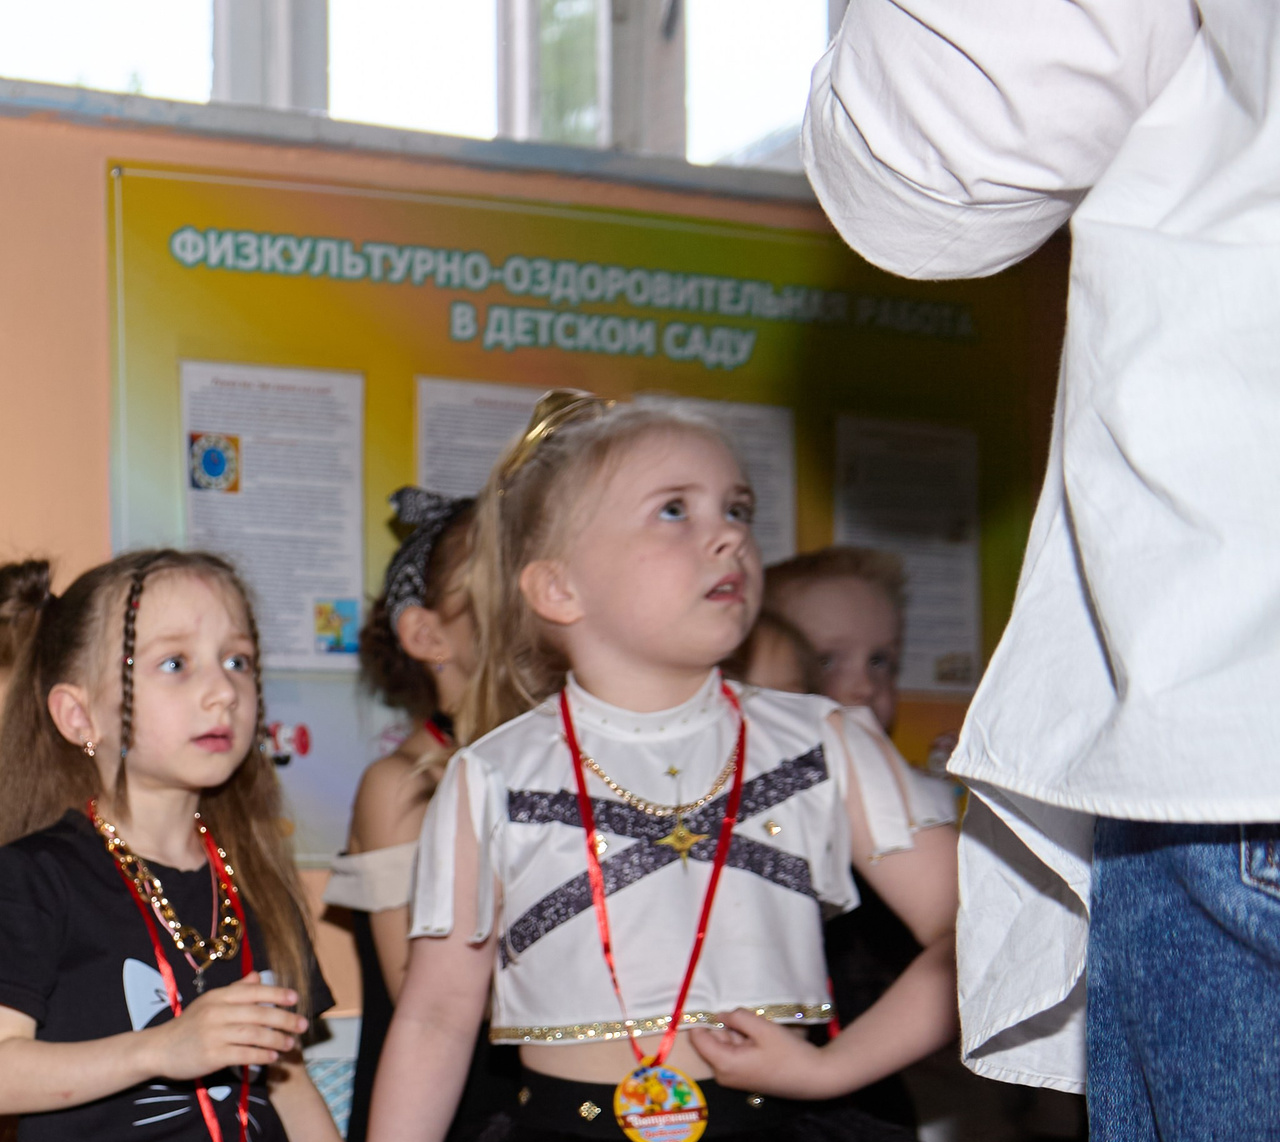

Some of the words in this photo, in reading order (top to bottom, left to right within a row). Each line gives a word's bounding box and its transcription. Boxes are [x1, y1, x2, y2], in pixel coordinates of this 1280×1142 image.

[171, 227, 847, 322] ФИЗКУЛЬТУРНО-ОЗДОРОВИТЕЛЬНАЯ
[450, 302, 478, 340] В
[484, 305, 657, 356] ДЕТСКОМ
[663, 321, 758, 371] САДУ
